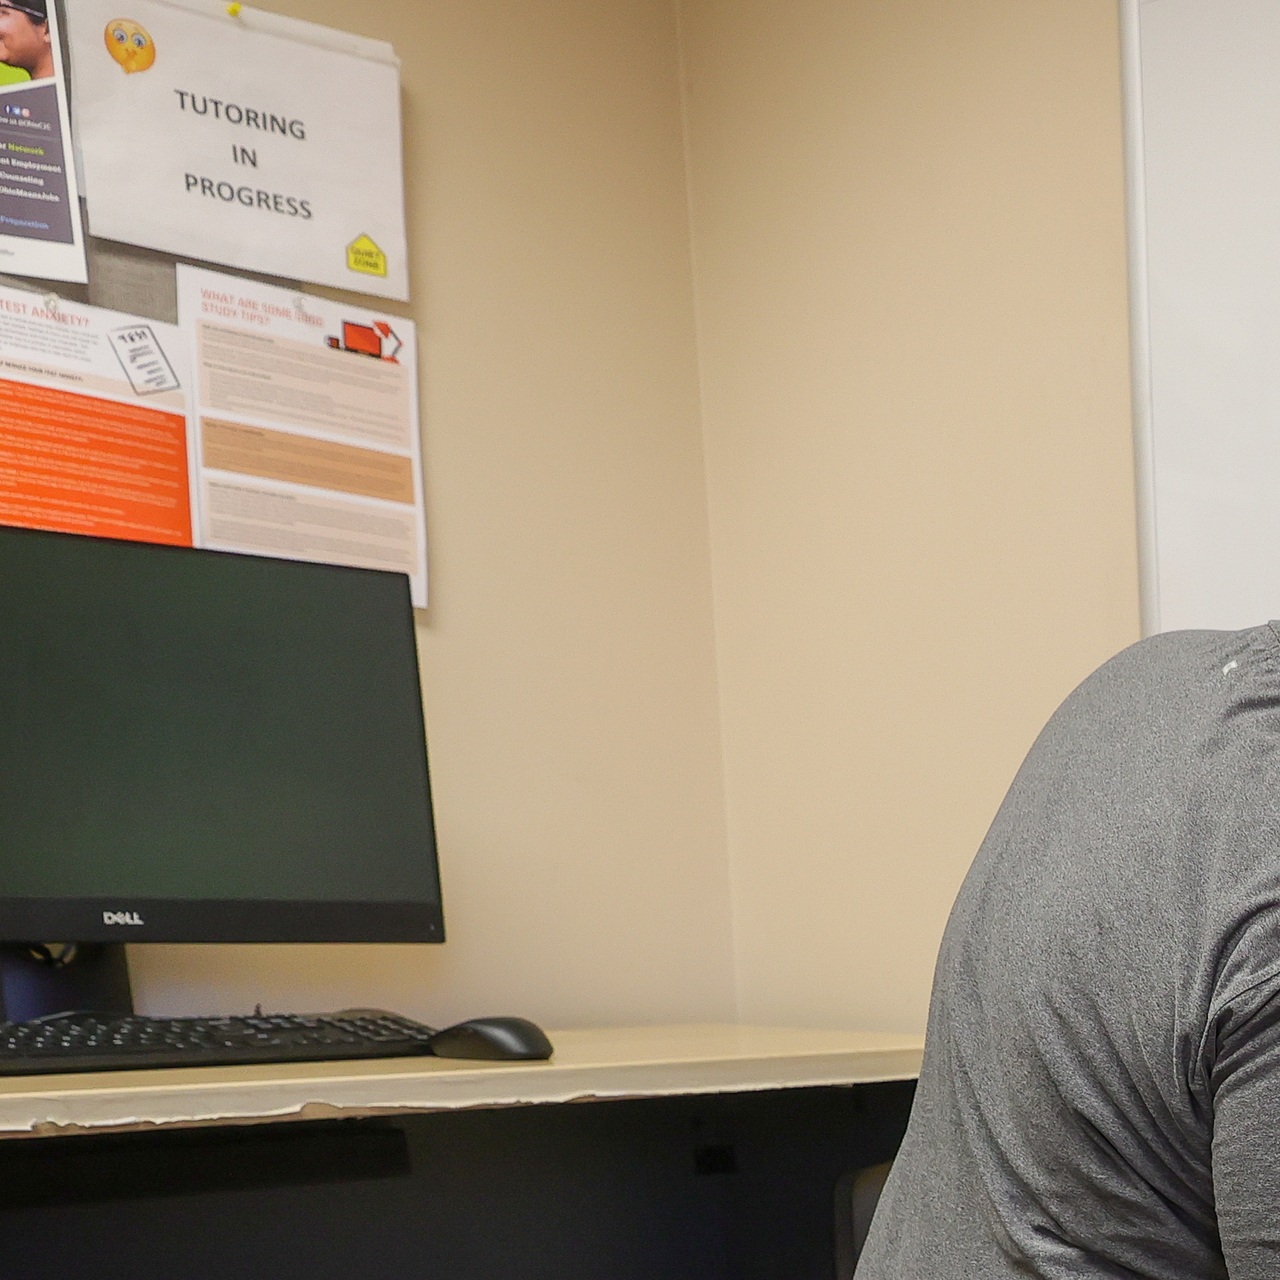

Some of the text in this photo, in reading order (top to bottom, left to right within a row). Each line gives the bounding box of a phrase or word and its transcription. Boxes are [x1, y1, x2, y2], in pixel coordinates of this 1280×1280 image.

[174, 89, 306, 141] TUTORING
[231, 144, 258, 168] IN
[184, 172, 313, 220] PROGRESS
[103, 911, 145, 925] DELL
